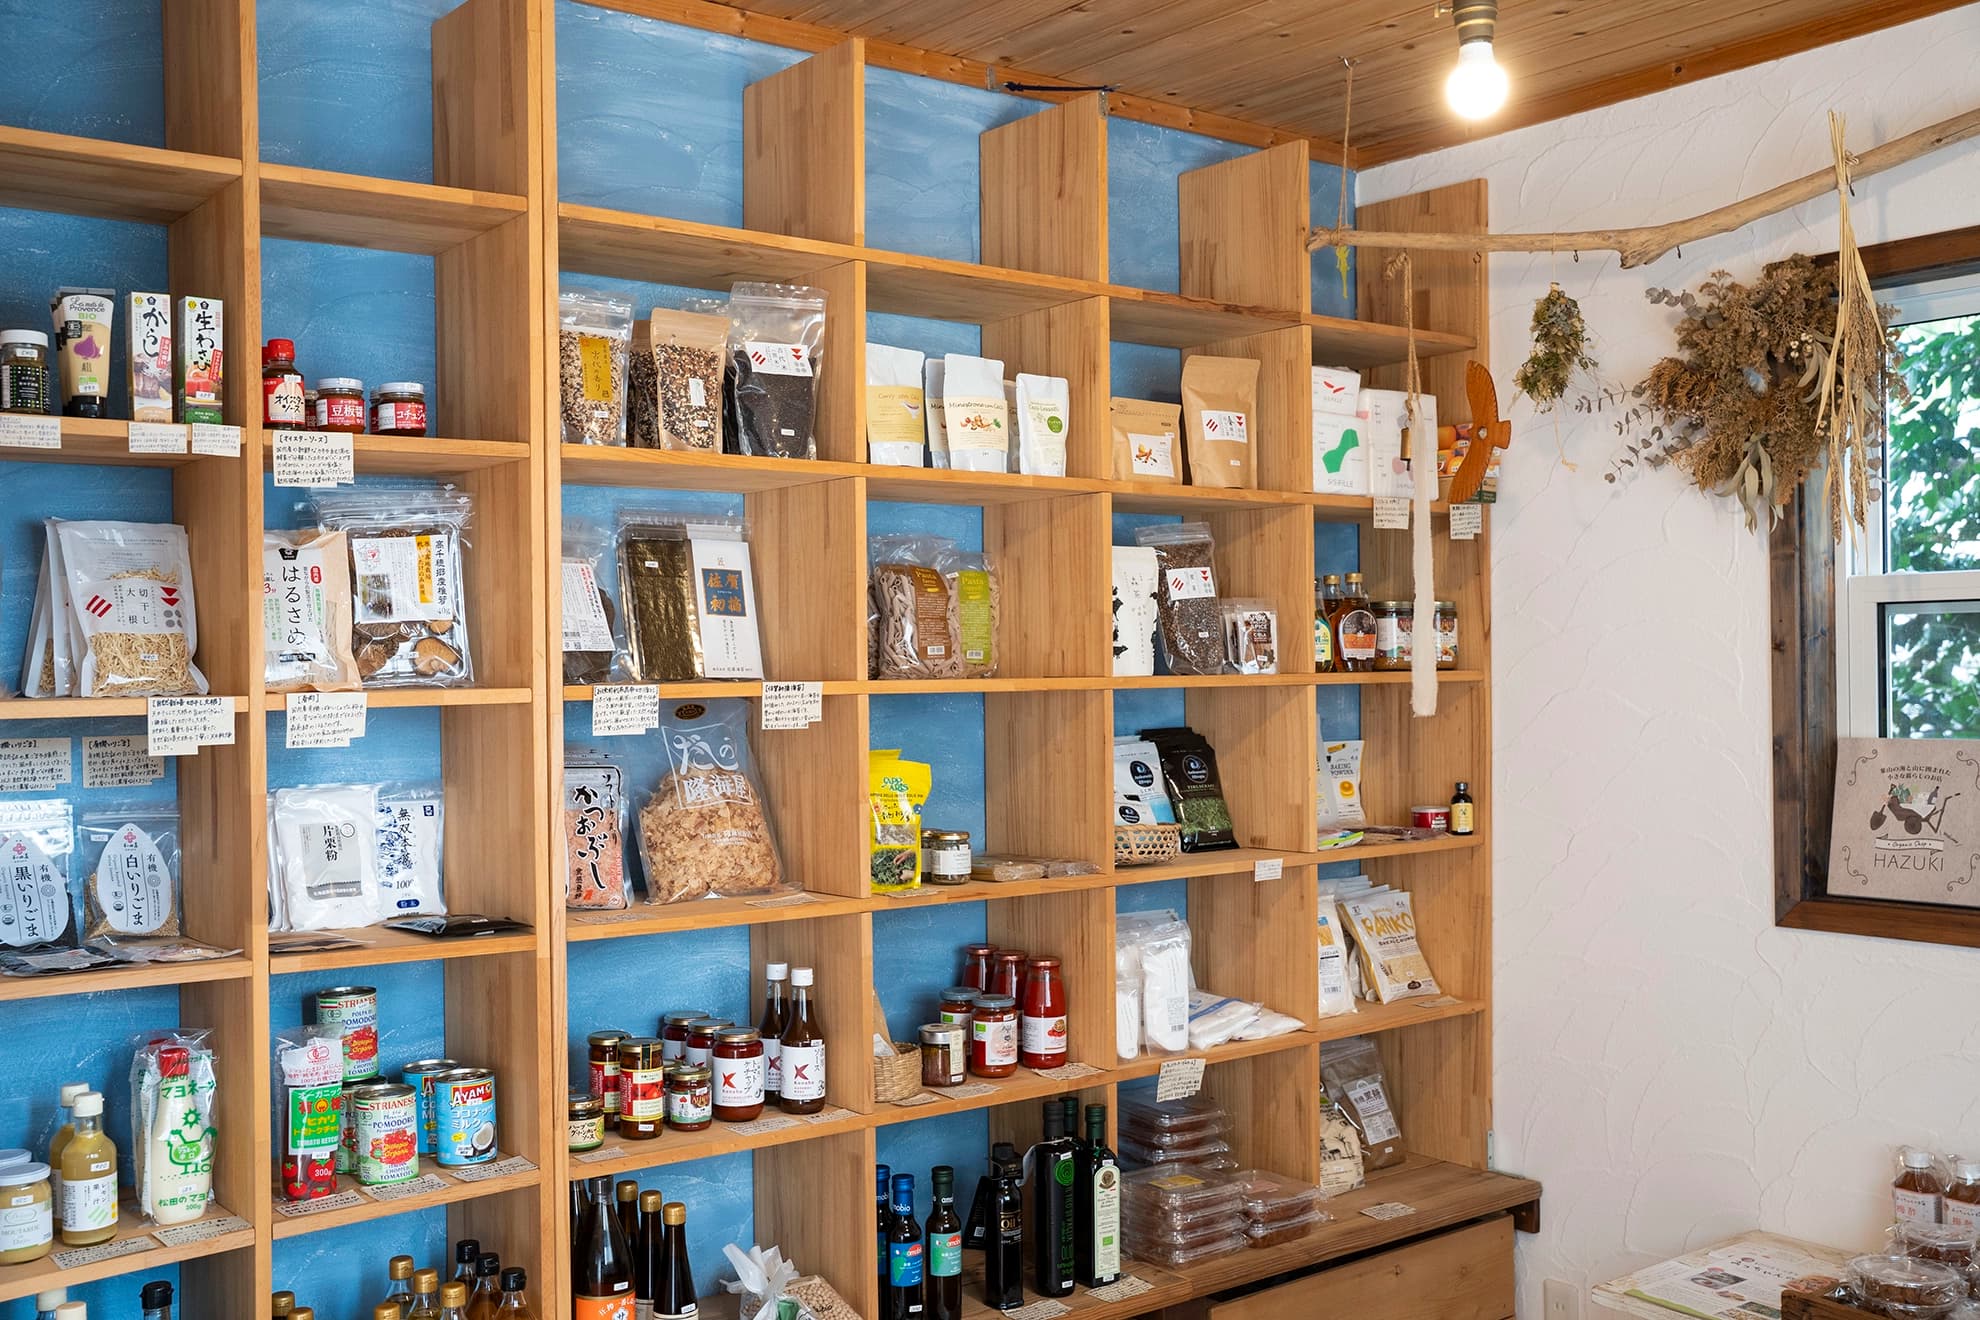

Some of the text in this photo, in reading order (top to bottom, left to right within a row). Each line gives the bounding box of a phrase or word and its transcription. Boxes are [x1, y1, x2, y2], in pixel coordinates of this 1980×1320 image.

[143, 307, 167, 357] からし
[193, 311, 215, 371] 生わさび
[396, 409, 426, 421] コチュジャ
[281, 566, 306, 646] はるさめ
[323, 825, 338, 861] 片栗粉
[575, 785, 608, 889] かつおぶし
[147, 854, 158, 872] 有機
[1874, 853, 1944, 871] HAZUKI
[40, 864, 52, 882] 有機
[127, 854, 145, 925] 白いりごま
[14, 866, 39, 937] 黒いりごま
[1361, 911, 1415, 937] PANKO
[449, 1085, 484, 1108] AYAM
[306, 1115, 336, 1126] ヒカリ
[452, 1104, 494, 1118] ココナッツ
[373, 1115, 414, 1128] POMODORO
[452, 1118, 480, 1129] ミルク
[158, 1191, 208, 1207] 松田のマヨ
